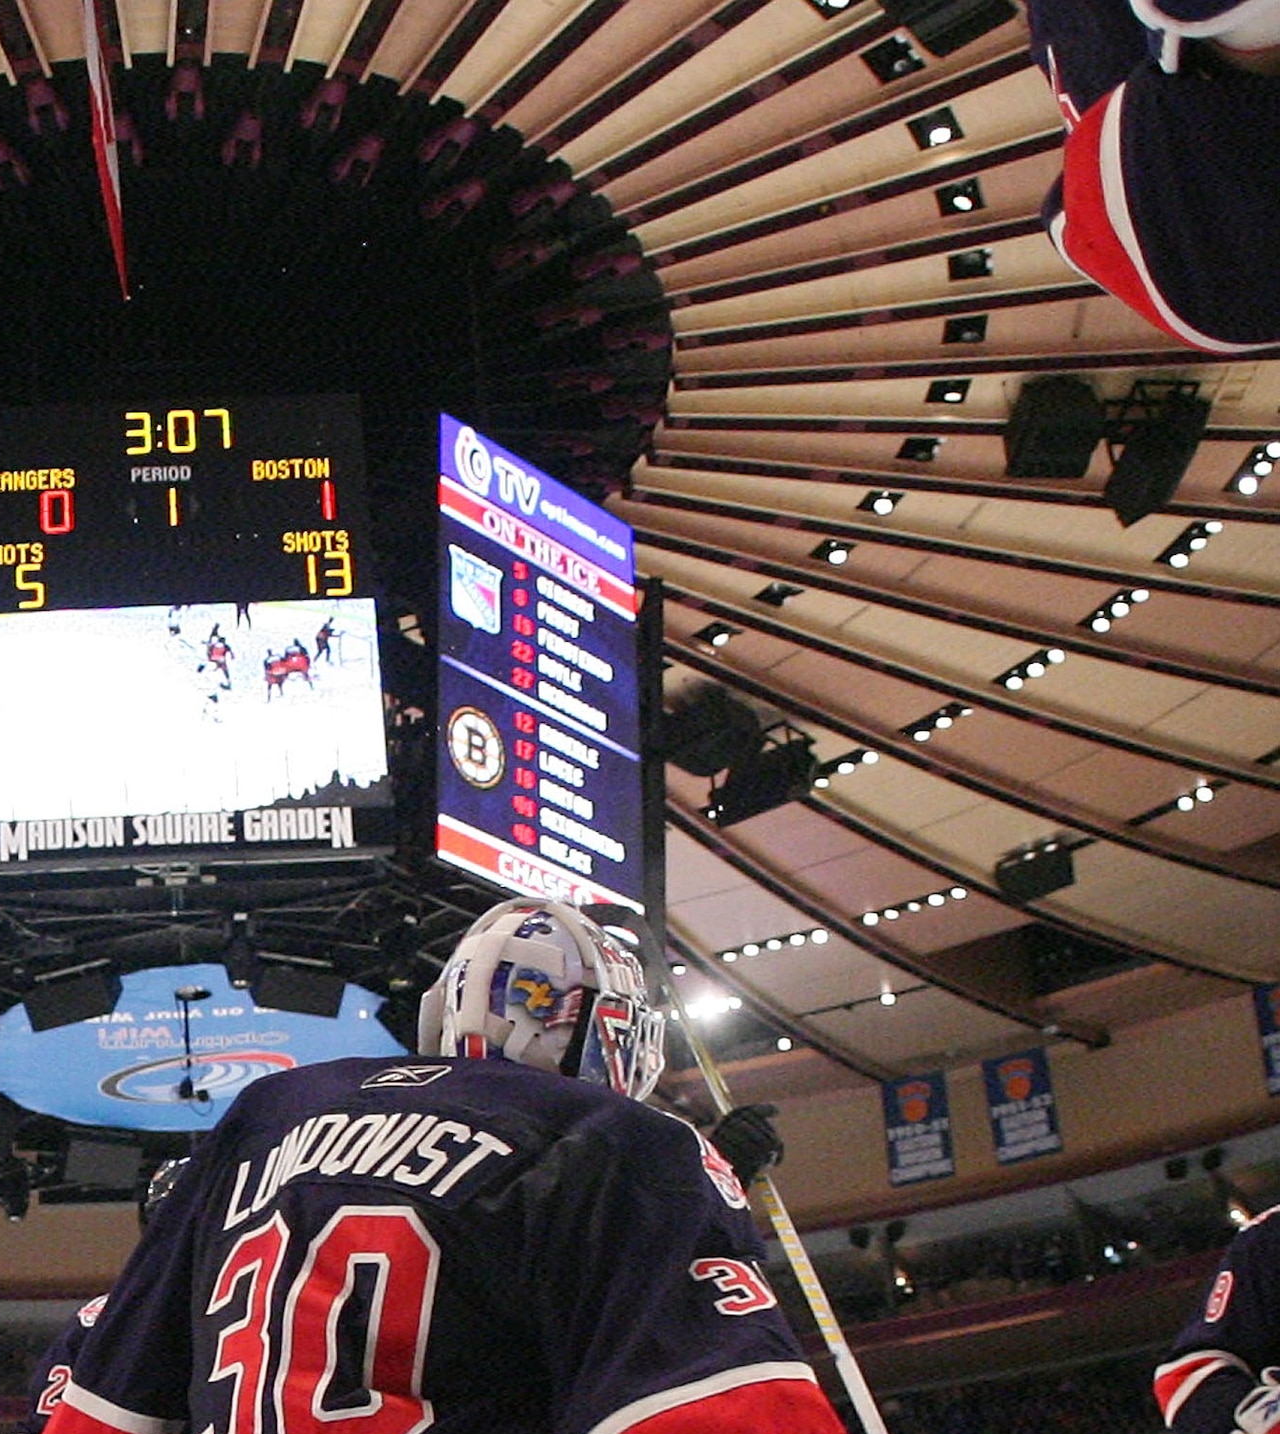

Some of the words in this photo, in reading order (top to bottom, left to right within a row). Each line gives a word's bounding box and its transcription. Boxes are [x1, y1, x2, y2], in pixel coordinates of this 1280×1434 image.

[125, 408, 231, 455] 3:07
[131, 465, 191, 483] PERIOD
[251, 457, 331, 481] BOSTON
[39, 490, 74, 534] 0
[168, 487, 179, 527] 1
[321, 480, 336, 520] 1
[282, 530, 349, 553] SHOTS
[483, 510, 519, 543] ON
[522, 528, 565, 568] THE
[565, 554, 601, 594] ICE
[14, 563, 45, 609] 5
[305, 551, 353, 597] 13
[513, 712, 536, 733] 12
[0, 817, 125, 862] MADISON
[132, 811, 236, 845] SQUARE
[244, 806, 357, 849] GARDEN
[498, 853, 573, 902] CHASE
[223, 1112, 514, 1231] LUNDQVIST
[688, 1256, 778, 1317] 3
